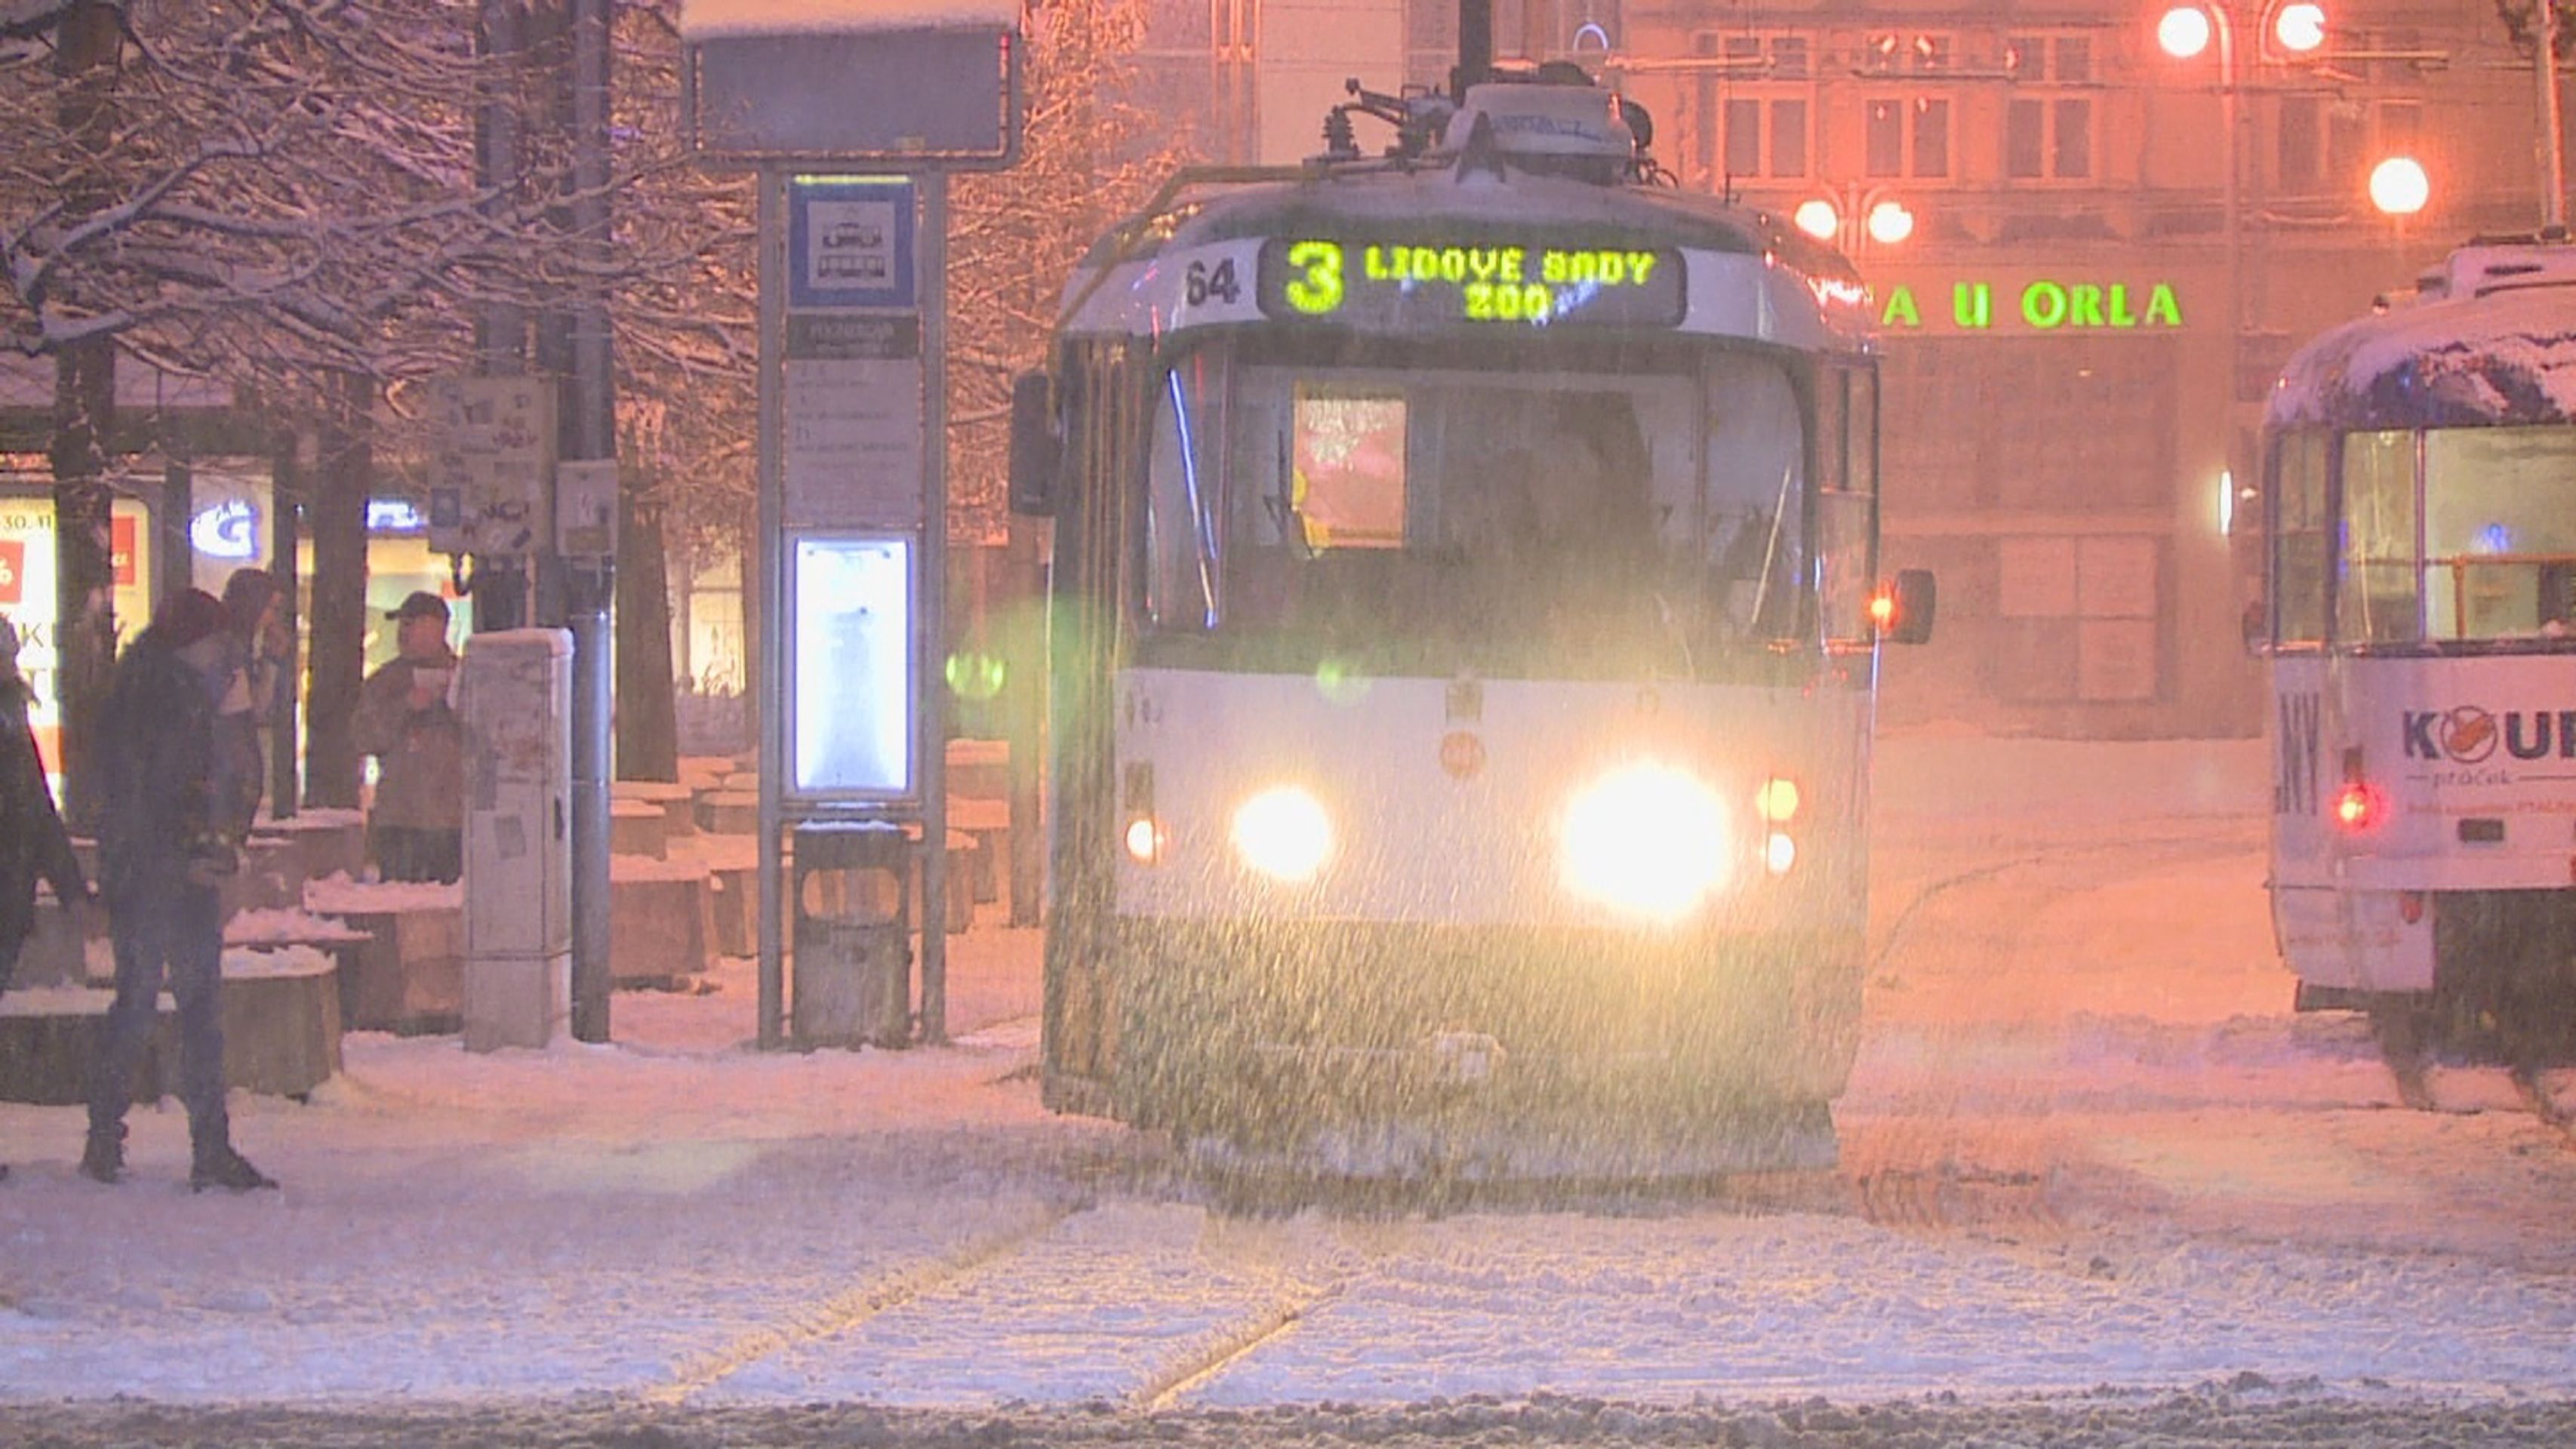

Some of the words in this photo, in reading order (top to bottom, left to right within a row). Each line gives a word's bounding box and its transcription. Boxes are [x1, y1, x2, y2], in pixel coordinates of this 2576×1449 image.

[1186, 258, 1242, 306] 64
[1286, 241, 1345, 314] 3
[1954, 282, 1992, 327] U
[2022, 281, 2182, 328] ORLA
